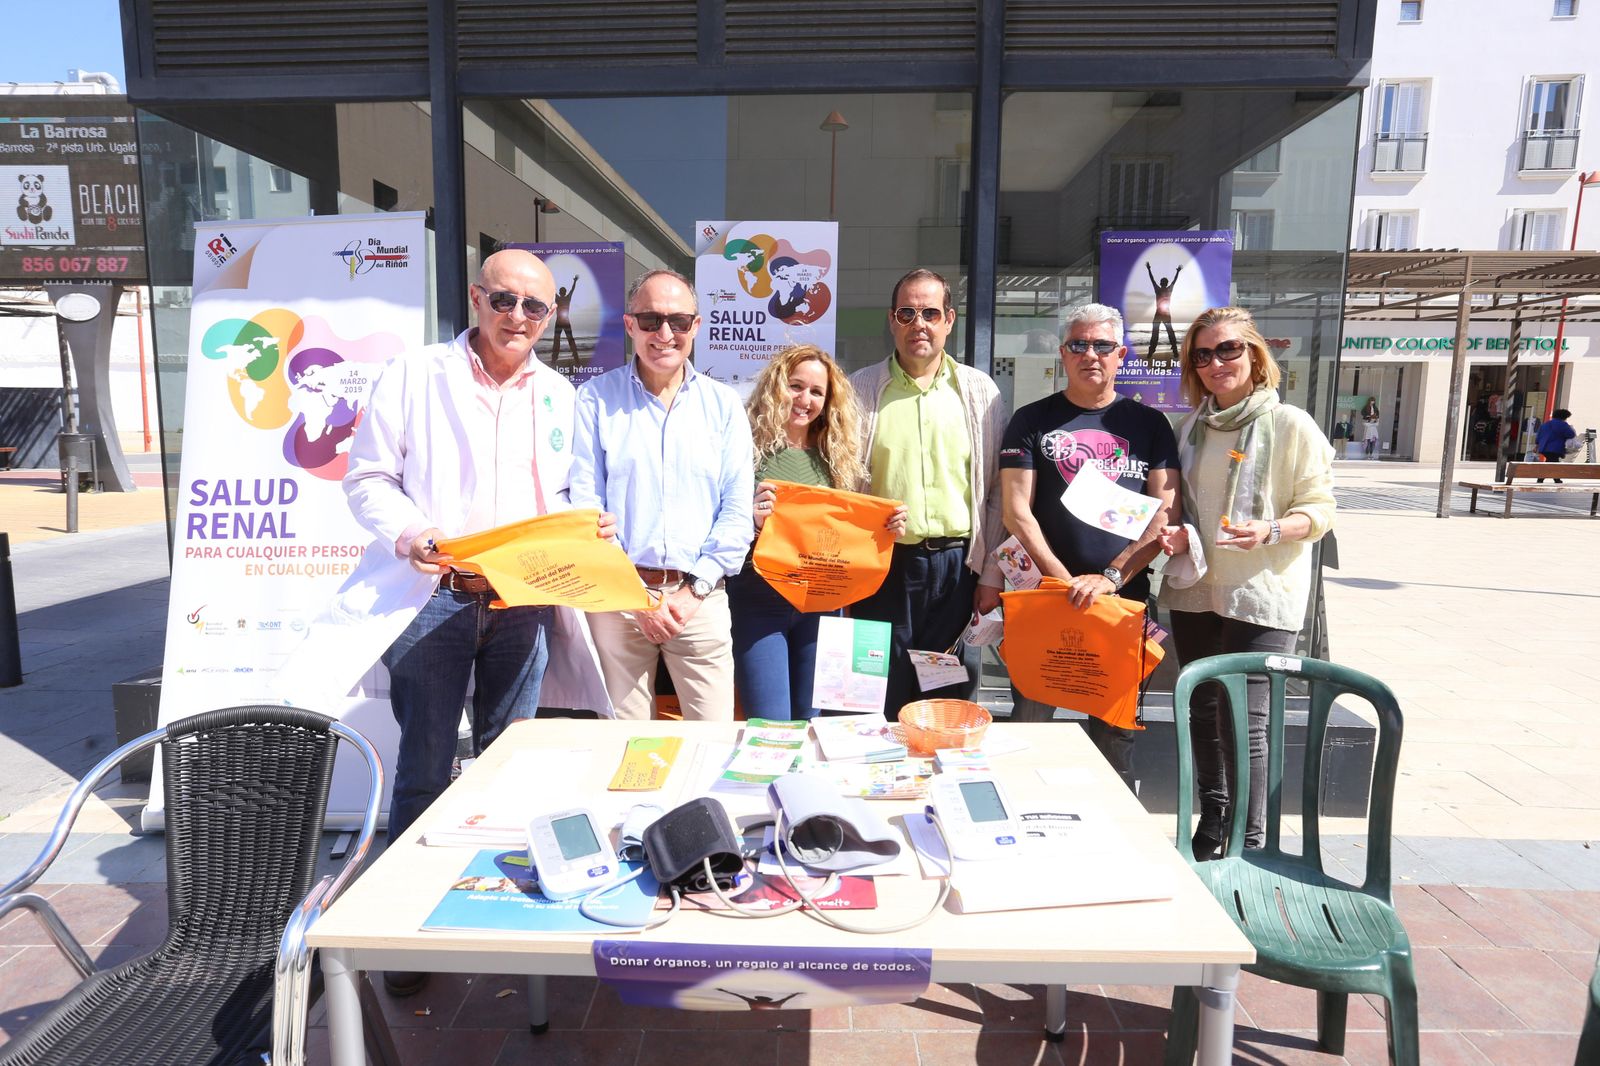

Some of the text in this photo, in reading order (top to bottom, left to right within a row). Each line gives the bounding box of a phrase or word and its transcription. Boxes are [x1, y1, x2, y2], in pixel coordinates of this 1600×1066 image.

[20, 124, 107, 139] La Barrosa
[61, 142, 84, 155] pista
[86, 142, 106, 153] Urb.
[79, 184, 139, 215] BEACH
[368, 238, 381, 246] Día
[376, 246, 408, 254] Mundial
[22, 256, 128, 272] 856 067 887
[385, 260, 408, 268] Riñón
[710, 310, 766, 325] SALUD
[709, 327, 766, 342] RENAL
[729, 344, 772, 352] CUALQUIER
[1395, 337, 1456, 351] COLORS
[1465, 337, 1483, 350] OF
[555, 365, 604, 374] los héroes
[1127, 358, 1149, 368] sólo
[1152, 358, 1167, 368] los
[1116, 366, 1182, 376] alvan vidas...
[344, 386, 363, 394] 2019
[189, 478, 299, 506] SALUD
[186, 511, 296, 540] RENAL
[185, 545, 368, 561] PARA CUALQUIER PERSON
[245, 564, 264, 576] EN
[267, 563, 350, 578] CUALQUIER
[548, 569, 557, 578] del
[557, 563, 576, 574] Riñón
[1280, 657, 1287, 667] 9
[610, 956, 915, 972] Donar órganos, un regalo al alcance de todos.
